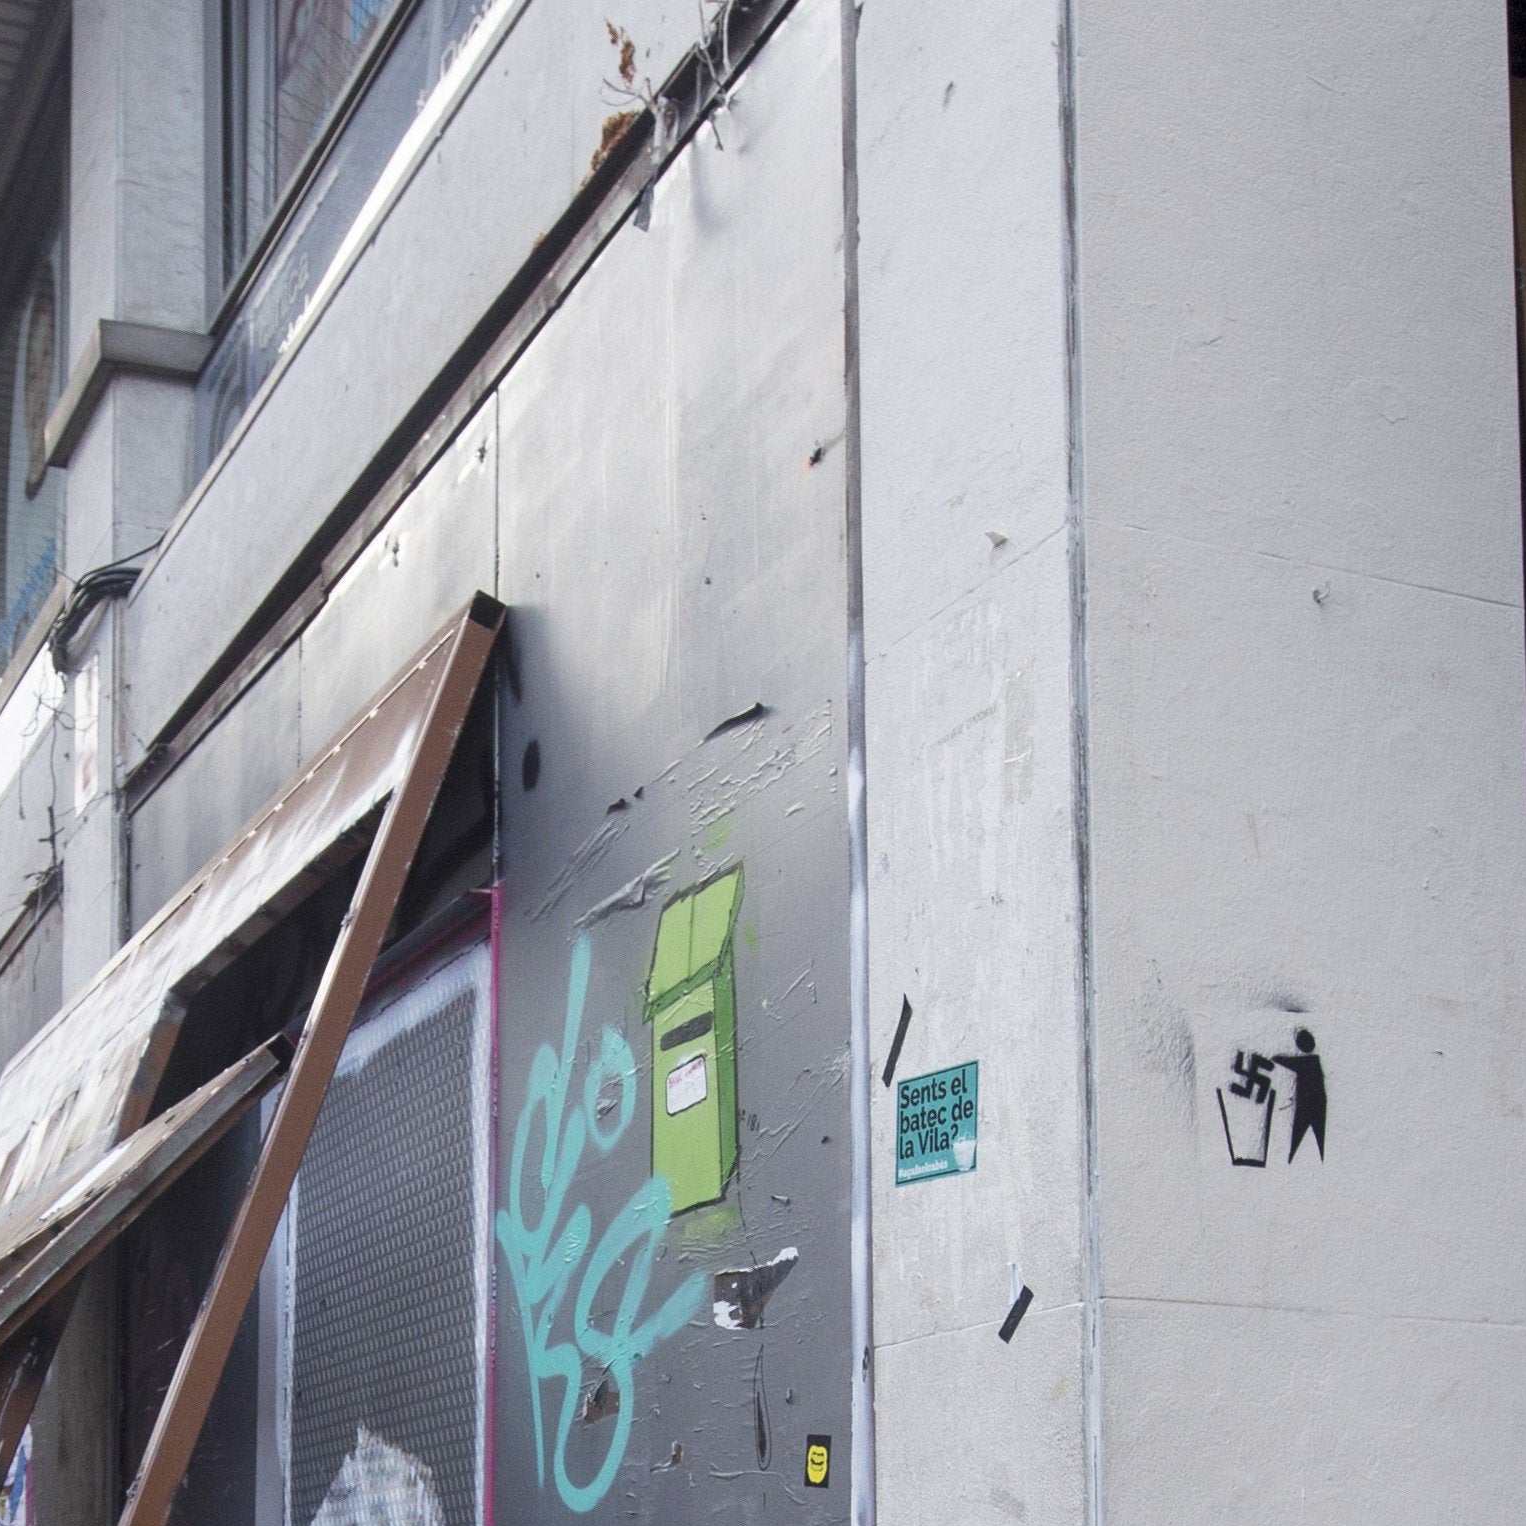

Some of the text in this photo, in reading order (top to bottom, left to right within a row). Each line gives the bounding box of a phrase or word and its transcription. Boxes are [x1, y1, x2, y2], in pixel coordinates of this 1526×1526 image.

[900, 1068, 968, 1109] Sents el
[900, 1095, 974, 1135] batec de
[899, 1123, 959, 1160] la Vila?
